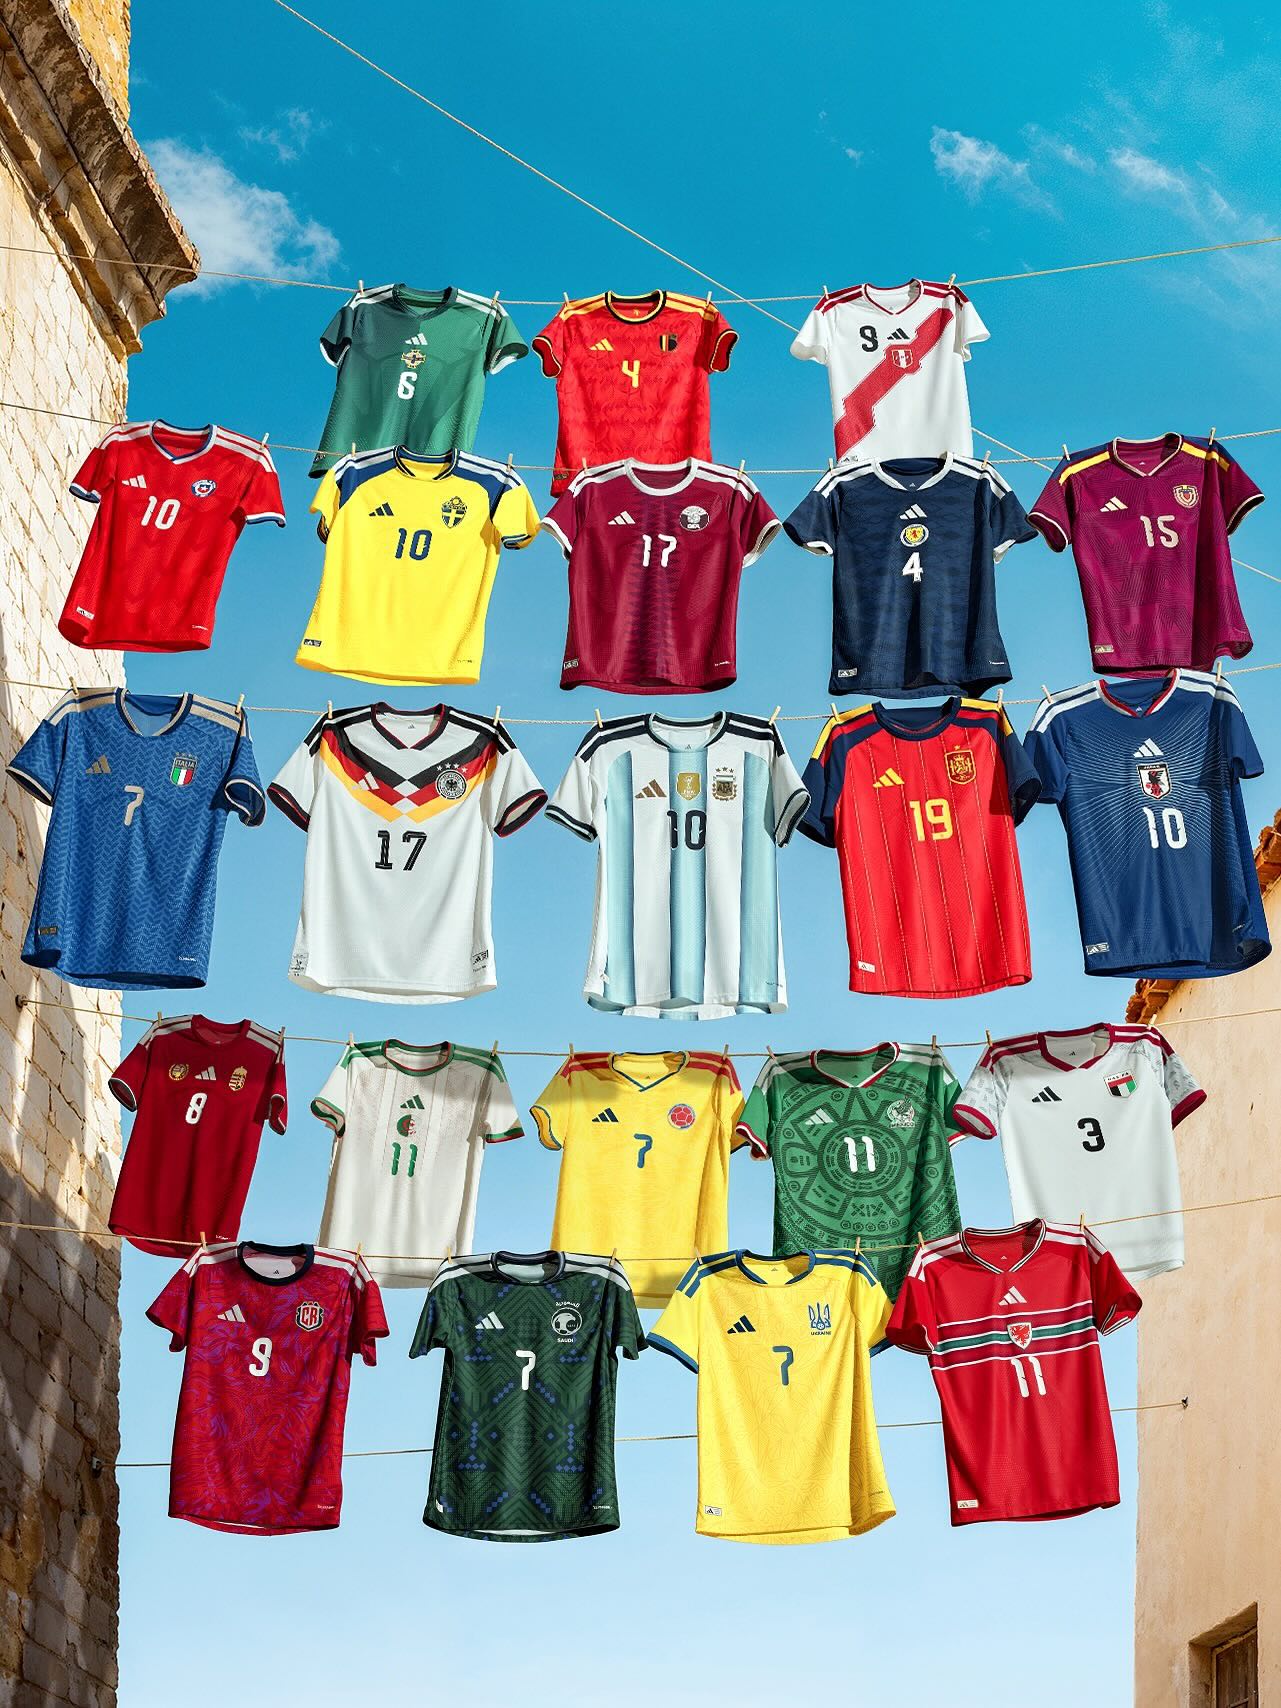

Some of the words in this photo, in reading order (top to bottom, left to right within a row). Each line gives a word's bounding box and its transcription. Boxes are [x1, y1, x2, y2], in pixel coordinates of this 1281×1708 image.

[858, 325, 879, 352] 9
[397, 371, 417, 400] 6
[621, 360, 640, 388] 4
[140, 495, 181, 530] 10
[394, 527, 432, 561] 10
[1139, 514, 1180, 548] 15
[642, 533, 677, 568] 17
[901, 552, 923, 582] 4
[175, 759, 196, 769] ITALIA
[123, 785, 144, 826] 7
[909, 798, 953, 842] 19
[666, 809, 708, 850] 10
[1141, 807, 1188, 850] 10
[374, 829, 427, 871] 17
[184, 1092, 208, 1125] 8
[633, 1133, 653, 1169] 7
[1076, 1116, 1106, 1152] 3
[391, 1141, 418, 1177] 11
[843, 1136, 875, 1173] 11
[248, 1337, 273, 1377] 9
[515, 1349, 536, 1391] 7
[773, 1345, 794, 1386] 7
[1010, 1355, 1047, 1398] 11
